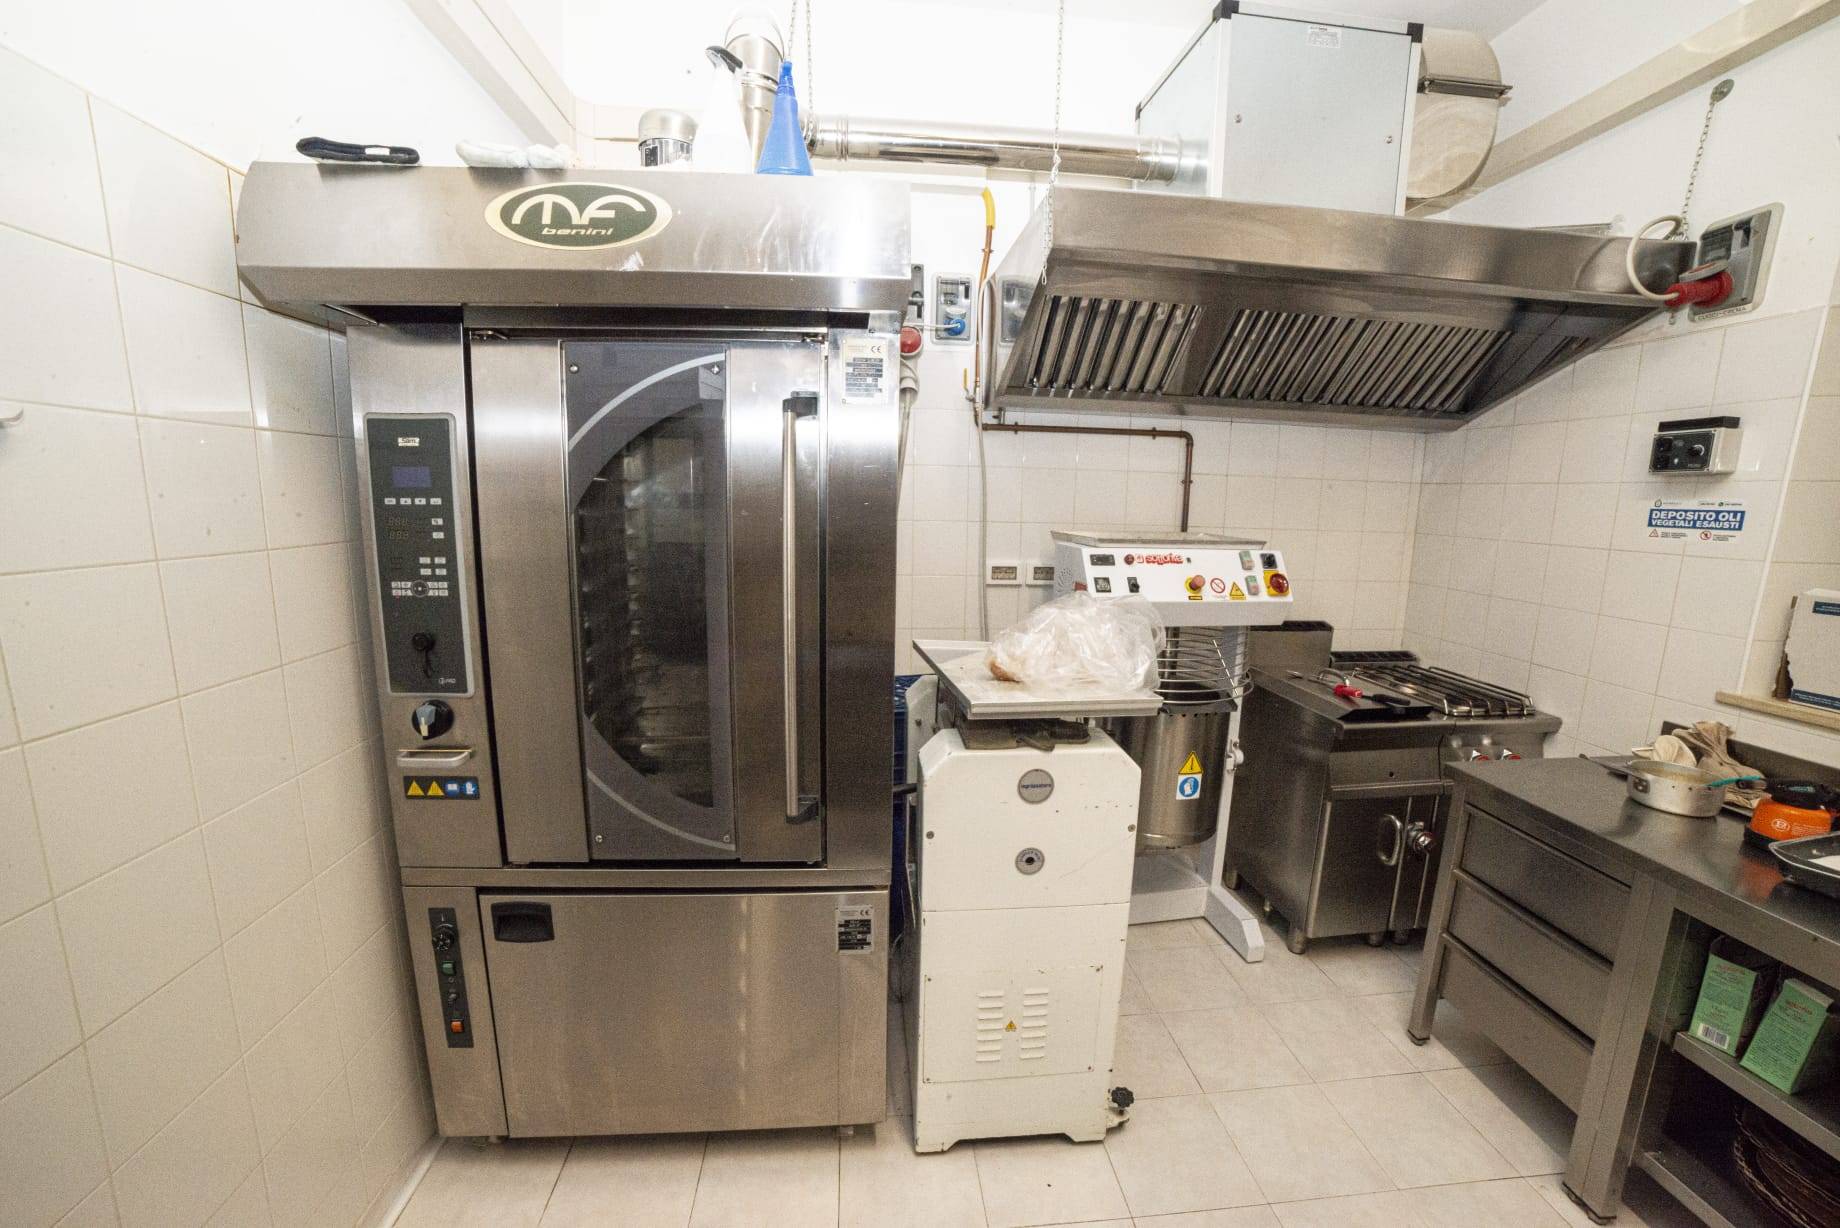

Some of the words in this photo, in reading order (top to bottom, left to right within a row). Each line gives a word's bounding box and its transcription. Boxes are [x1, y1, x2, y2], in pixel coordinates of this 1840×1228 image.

[541, 227, 614, 236] benini
[1652, 510, 1716, 521] DEPOSITO
[1718, 512, 1741, 522] OLI
[1651, 519, 1693, 527] VEGETALI
[1695, 520, 1740, 529] ESAUSTI
